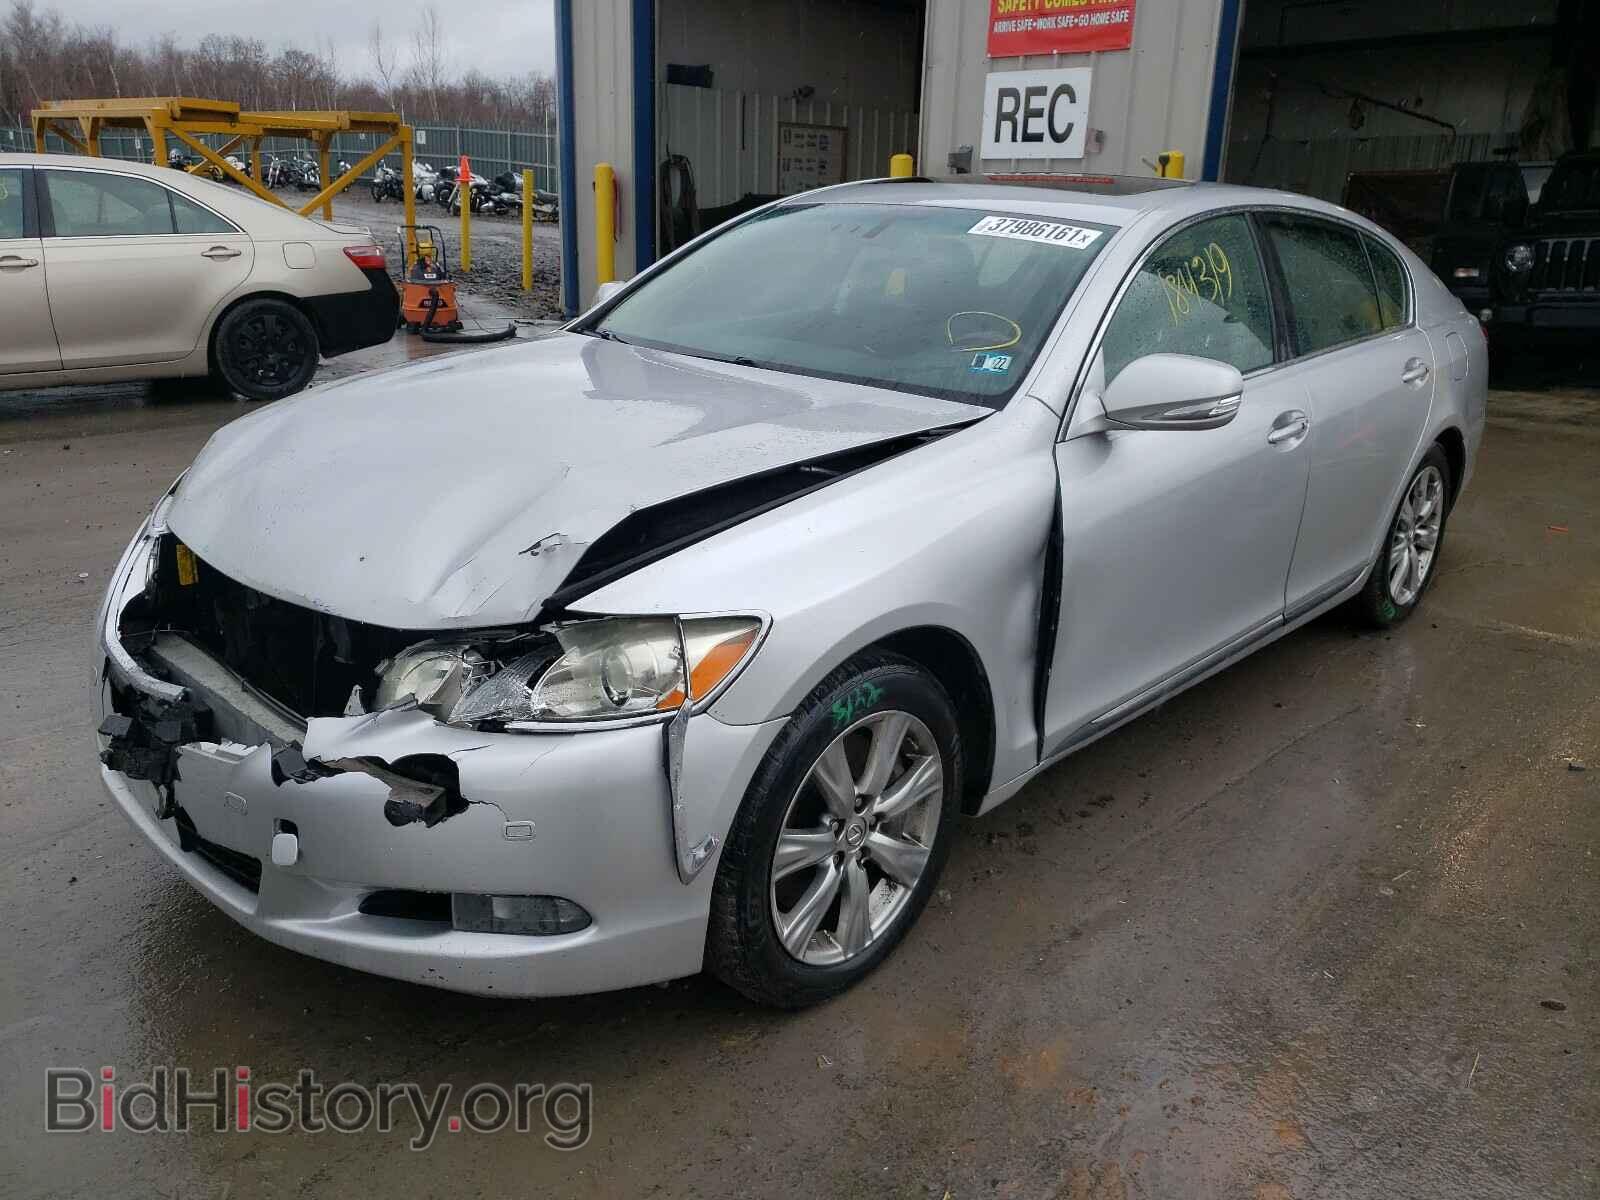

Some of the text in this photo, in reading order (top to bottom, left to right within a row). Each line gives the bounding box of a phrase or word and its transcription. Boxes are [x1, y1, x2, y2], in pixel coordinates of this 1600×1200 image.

[1056, 15, 1074, 29] SAFE
[1078, 13, 1090, 27] GO
[1089, 11, 1110, 26] HOME
[1110, 9, 1130, 23] SAFE
[994, 83, 1077, 144] REC
[988, 218, 1083, 241] 37986161
